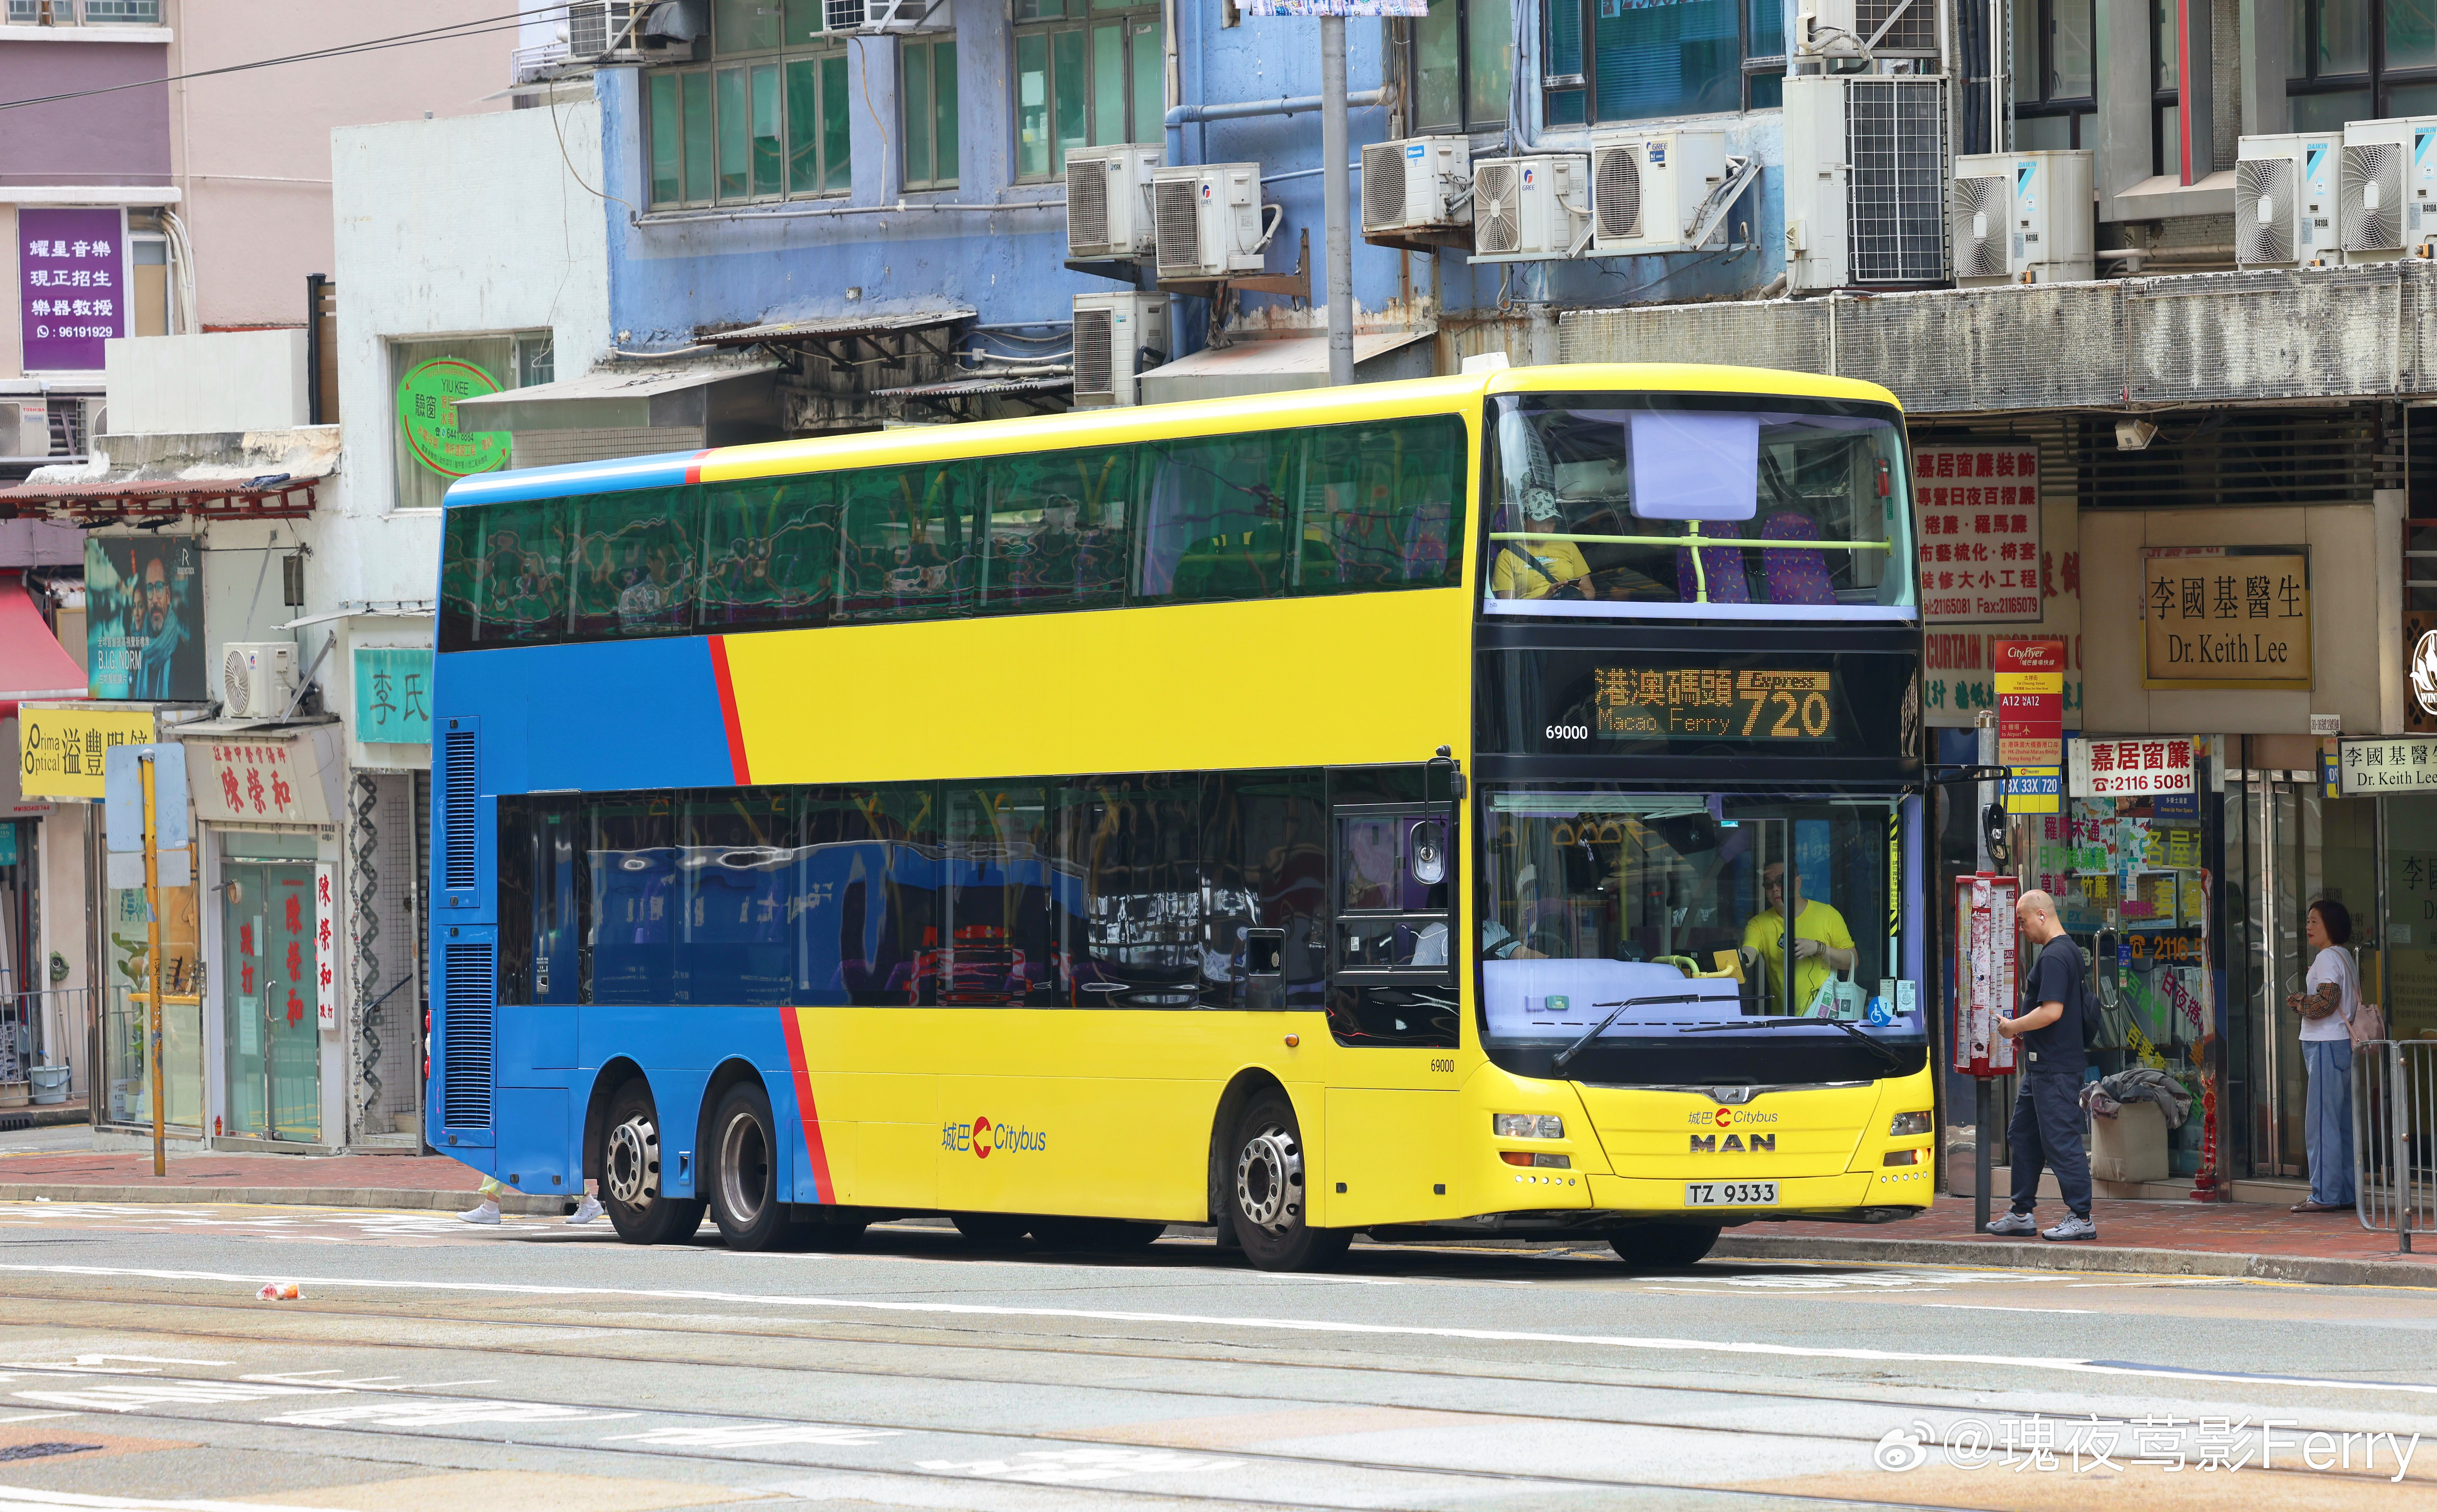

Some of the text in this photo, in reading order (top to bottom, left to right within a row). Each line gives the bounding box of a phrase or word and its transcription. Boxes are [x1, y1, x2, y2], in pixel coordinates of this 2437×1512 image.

[2423, 204, 2437, 212] R410A
[2315, 219, 2328, 227] R410A
[29, 240, 111, 258] 耀星音樂
[30, 270, 112, 287] 現正招生
[31, 299, 113, 317] 樂器教授
[441, 378, 469, 395] YIU KEE
[415, 393, 436, 419] 驗窗
[1916, 452, 2036, 478] 嘉居窗簾裝飾
[1917, 486, 2036, 507] 專營日夜百摺簾
[177, 567, 195, 575] RODENSTOCK
[1924, 597, 2038, 615] el:21165081 Fax:21165079
[2151, 574, 2303, 621] 李國基醫生
[1926, 634, 1981, 670] CURTAIN
[2168, 633, 2287, 663] Dr. Keith Lee
[98, 650, 142, 670] B.I.G. NORM
[1595, 668, 1733, 706] 港澳碼頭
[1750, 671, 1816, 689] Express
[370, 669, 429, 725] 李氏
[2002, 696, 2020, 706] A12
[1598, 707, 1730, 736] Macao Ferry
[1739, 690, 1829, 737] 720
[1545, 725, 1588, 739] 69000
[25, 750, 60, 775] Optical
[2091, 740, 2190, 771] 嘉居窗簾
[2021, 778, 2038, 793] 33X
[2042, 778, 2057, 793] 720
[2154, 774, 2191, 789] 5081
[2357, 773, 2375, 786] Dr.
[2378, 771, 2412, 785] Keith
[221, 766, 292, 815] 陳榮和
[2080, 875, 2108, 899] 竹簾
[2108, 909, 2114, 918] 推
[319, 873, 332, 992] 陳榮和
[2154, 936, 2189, 961] 2116
[285, 893, 303, 1029] 陳榮和
[1430, 1059, 1455, 1073] 69000
[1687, 1110, 1778, 1125] 城巴 Citybus
[942, 1121, 1046, 1154] 城巴 Citybus
[1690, 1133, 1775, 1153] MAN
[1690, 1184, 1774, 1203] TZ 9333
